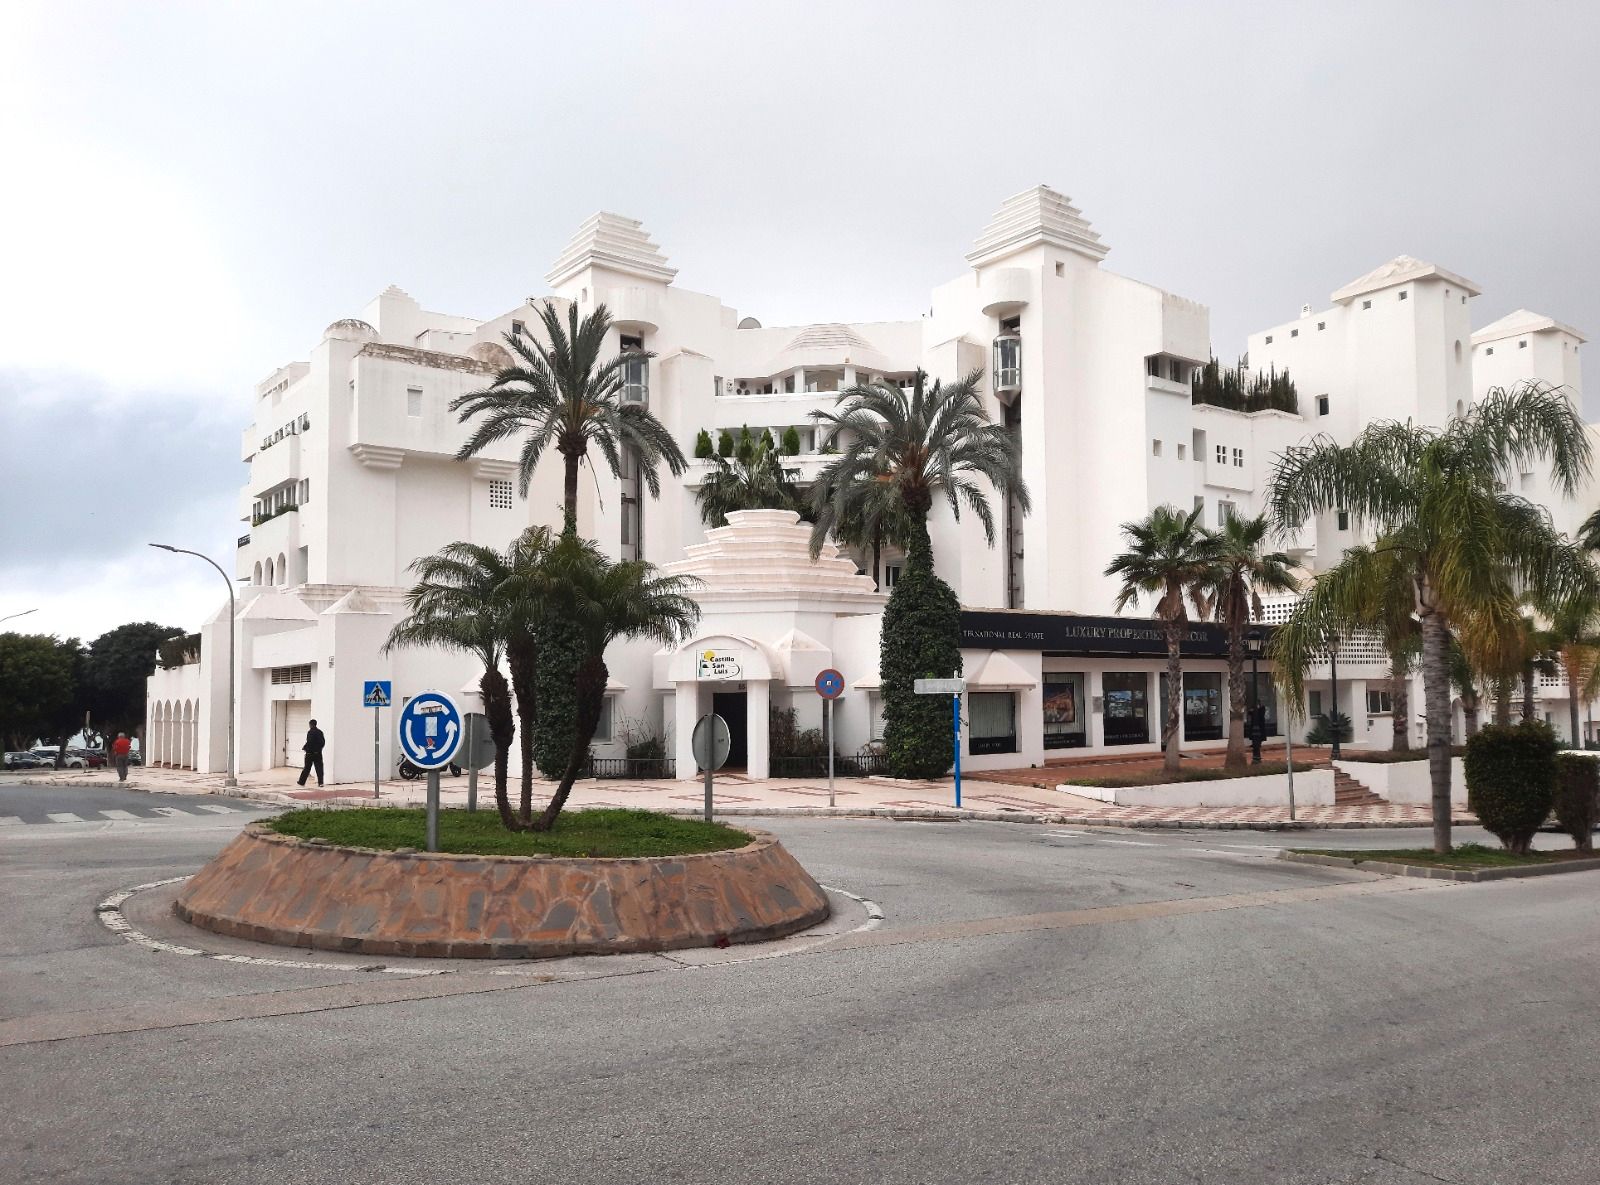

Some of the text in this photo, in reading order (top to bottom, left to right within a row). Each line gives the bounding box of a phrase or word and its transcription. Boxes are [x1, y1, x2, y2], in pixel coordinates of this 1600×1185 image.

[962, 630, 1005, 639] TERNATIONAL
[1065, 626, 1106, 638] LUXURY
[1108, 627, 1163, 641] PROPERTIES
